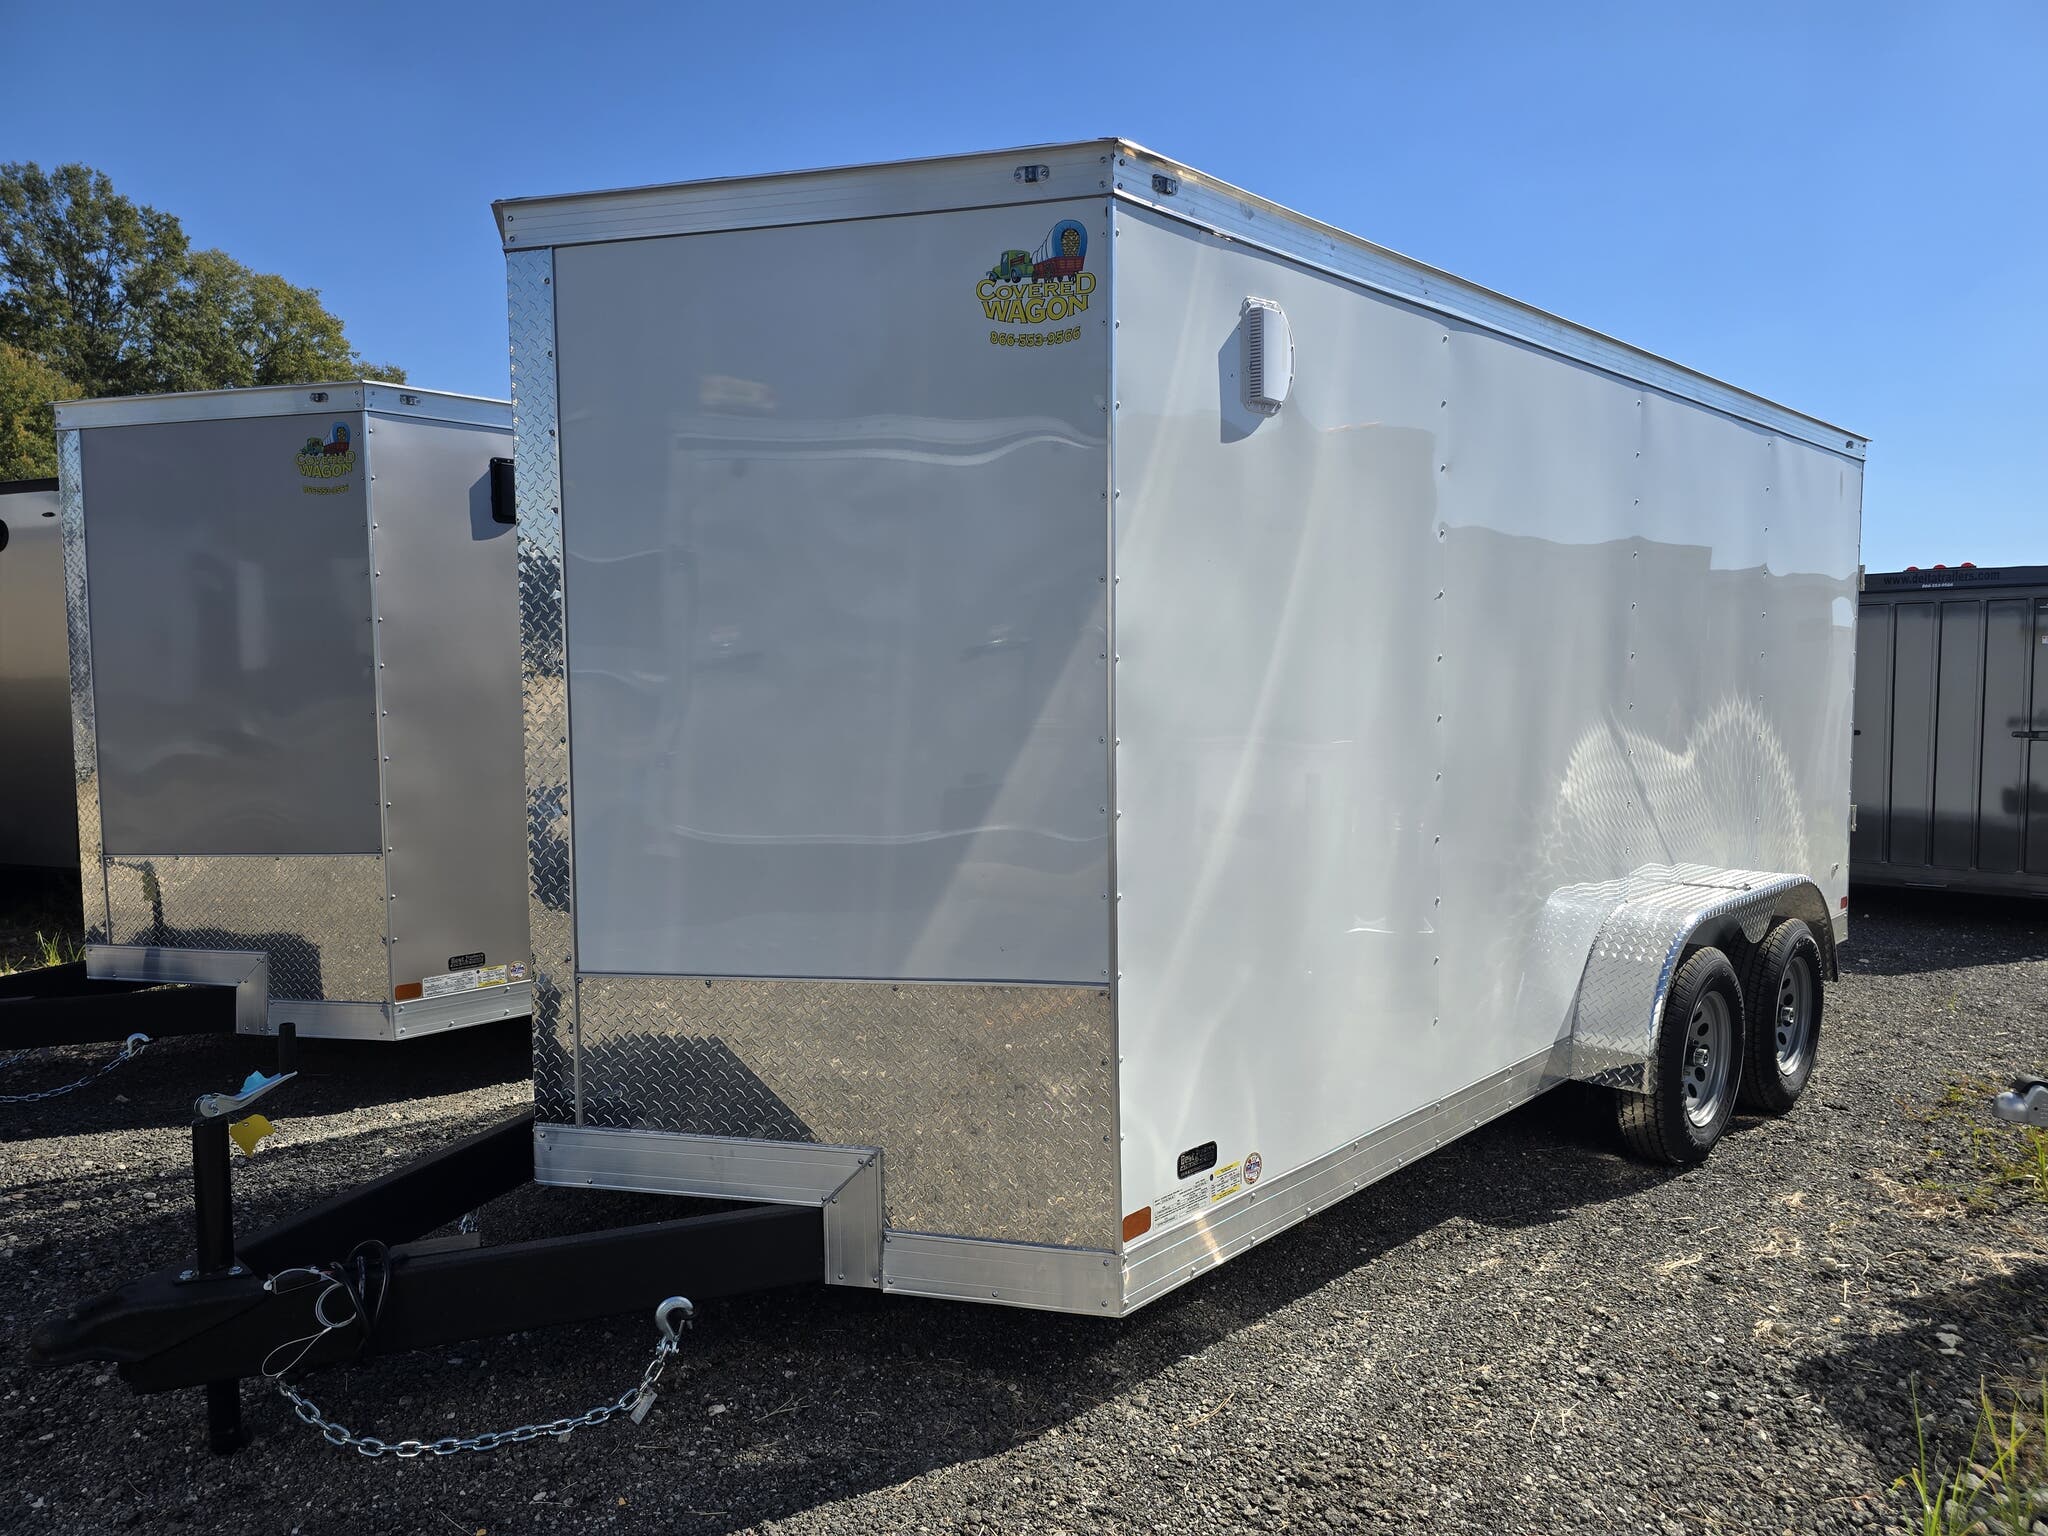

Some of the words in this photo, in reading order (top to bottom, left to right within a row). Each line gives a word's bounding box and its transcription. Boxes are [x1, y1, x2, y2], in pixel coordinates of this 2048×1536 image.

[976, 272, 1096, 300] COVERED
[982, 295, 1089, 323] WAGON
[990, 327, 1081, 347] 866-553-9566
[300, 463, 353, 478] WAGON
[1883, 571, 2000, 585] www.deltatrailers.com
